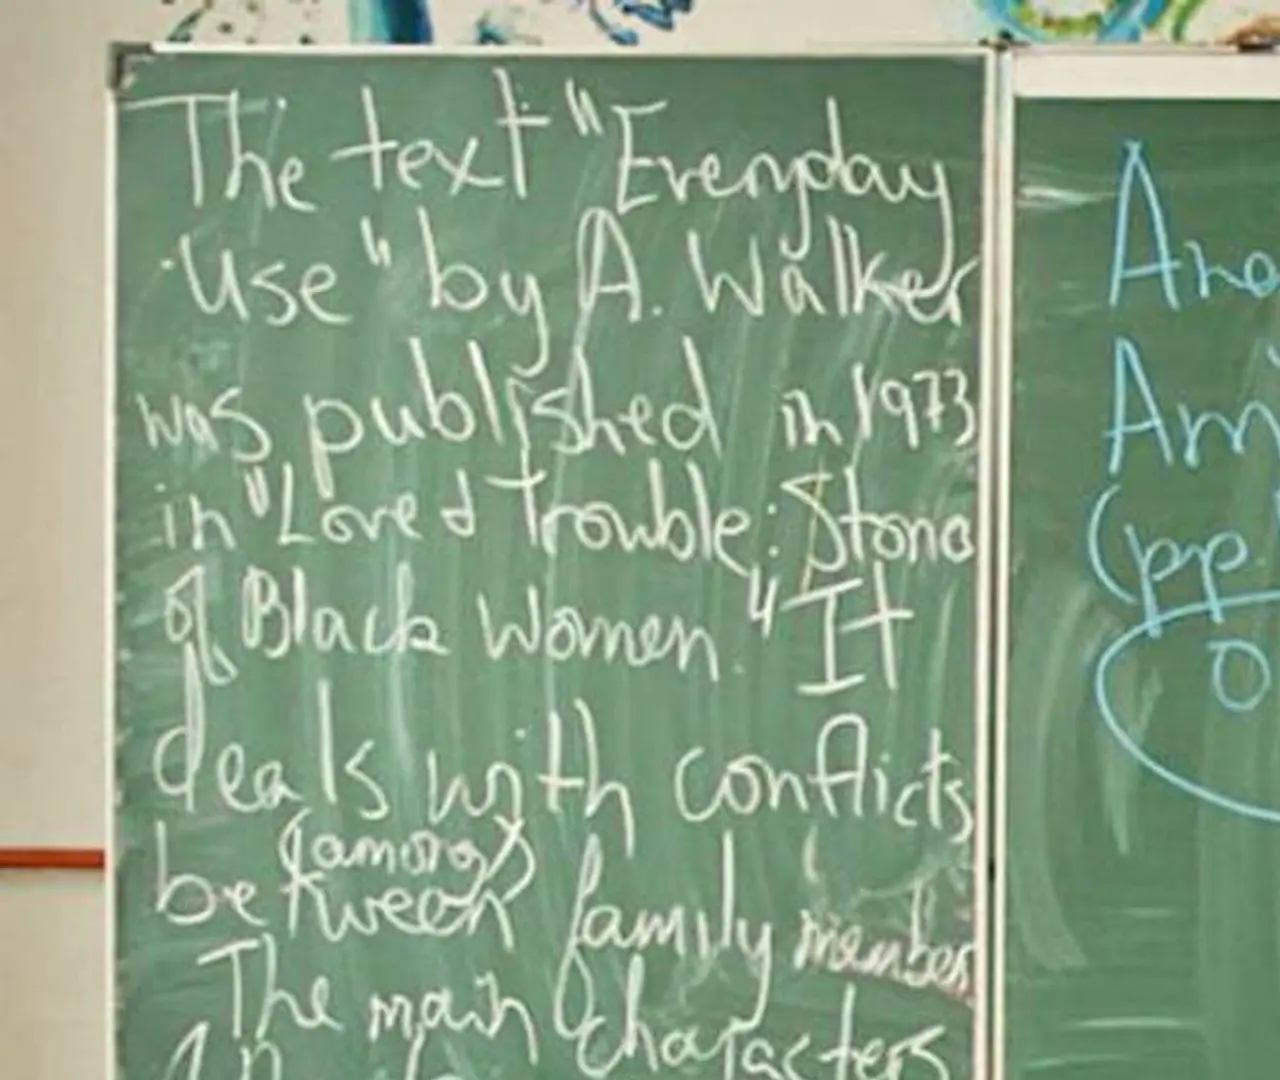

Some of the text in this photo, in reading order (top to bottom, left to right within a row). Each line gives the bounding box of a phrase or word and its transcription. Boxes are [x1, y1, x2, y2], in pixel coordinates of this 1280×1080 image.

[121, 90, 316, 212] The
[331, 67, 551, 197] text
[418, 207, 551, 378] by
[576, 207, 662, 322] A.
[686, 215, 980, 326] Walker
[136, 335, 977, 500] was published in 1973
[156, 482, 237, 551] in
[162, 564, 238, 688] of
[240, 564, 454, 660] Black
[778, 561, 918, 695] It
[153, 643, 975, 860] deals with conflicts
[197, 934, 342, 1040] The
[367, 977, 540, 1066] main
[554, 833, 776, 1032] family
